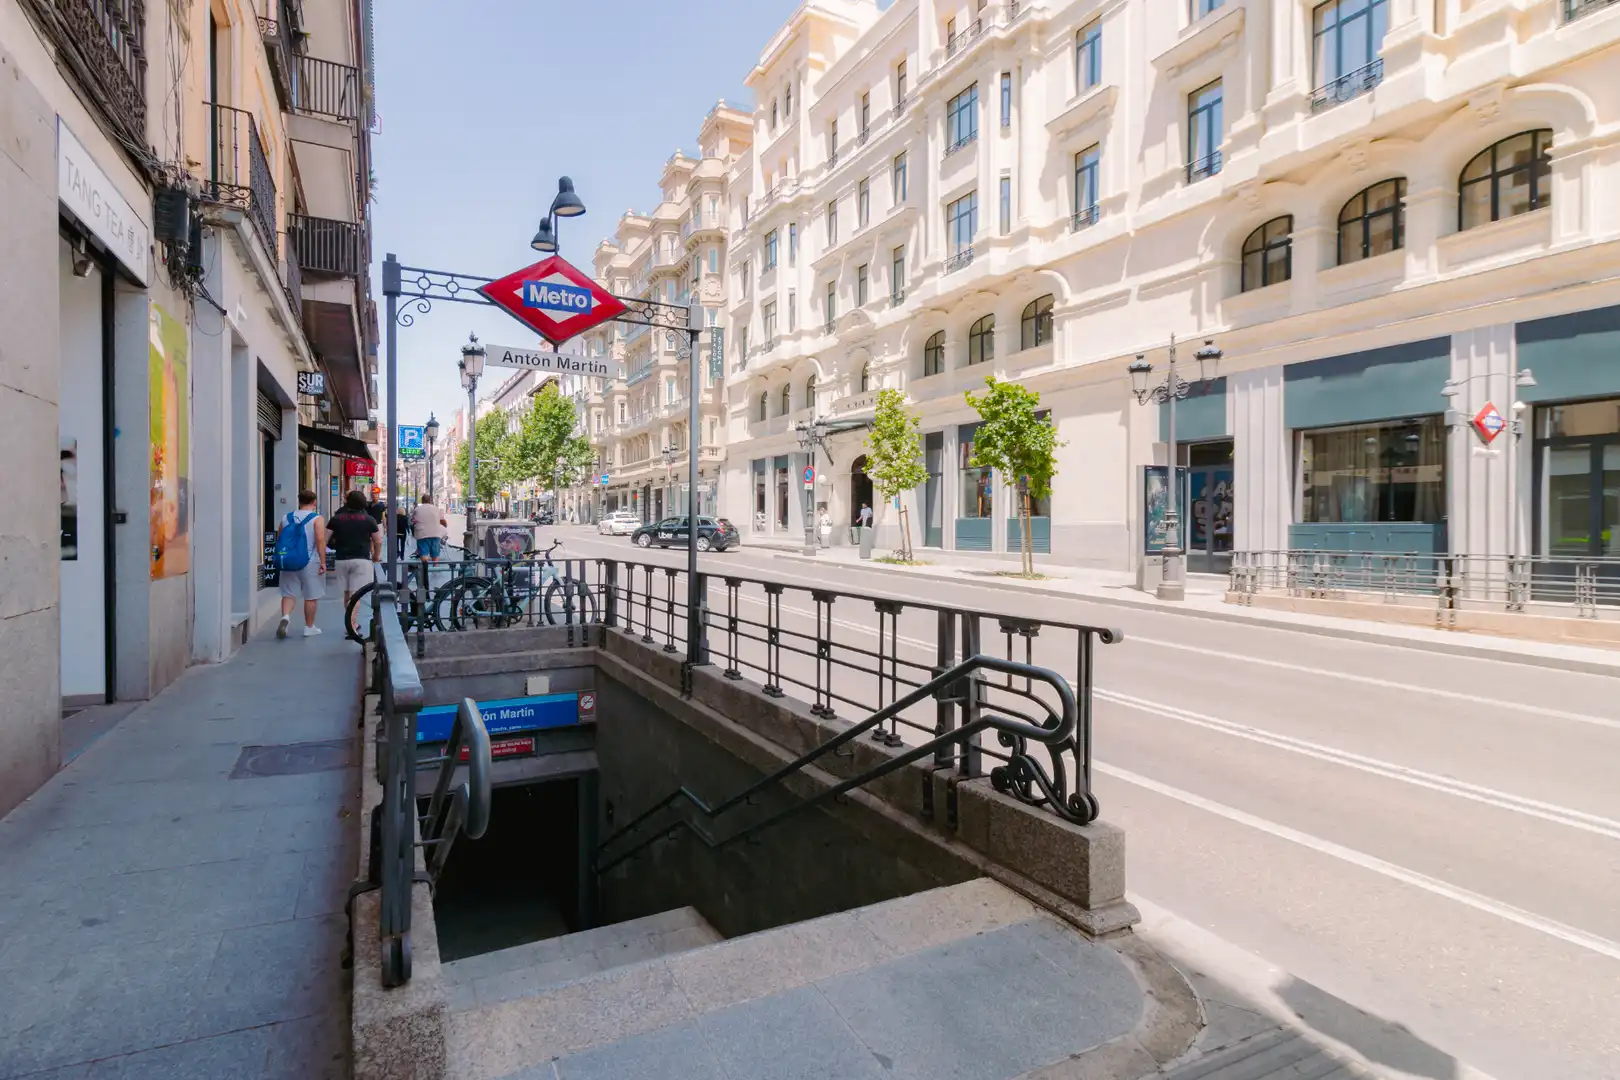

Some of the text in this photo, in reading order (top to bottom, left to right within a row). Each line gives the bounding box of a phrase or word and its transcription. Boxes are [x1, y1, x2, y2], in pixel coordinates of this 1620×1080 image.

[64, 155, 124, 242] TANG TEA
[529, 284, 588, 308] Metro
[501, 350, 551, 368] Antón
[298, 372, 324, 389] SUR
[404, 429, 418, 446] P
[500, 706, 534, 719] Martín
